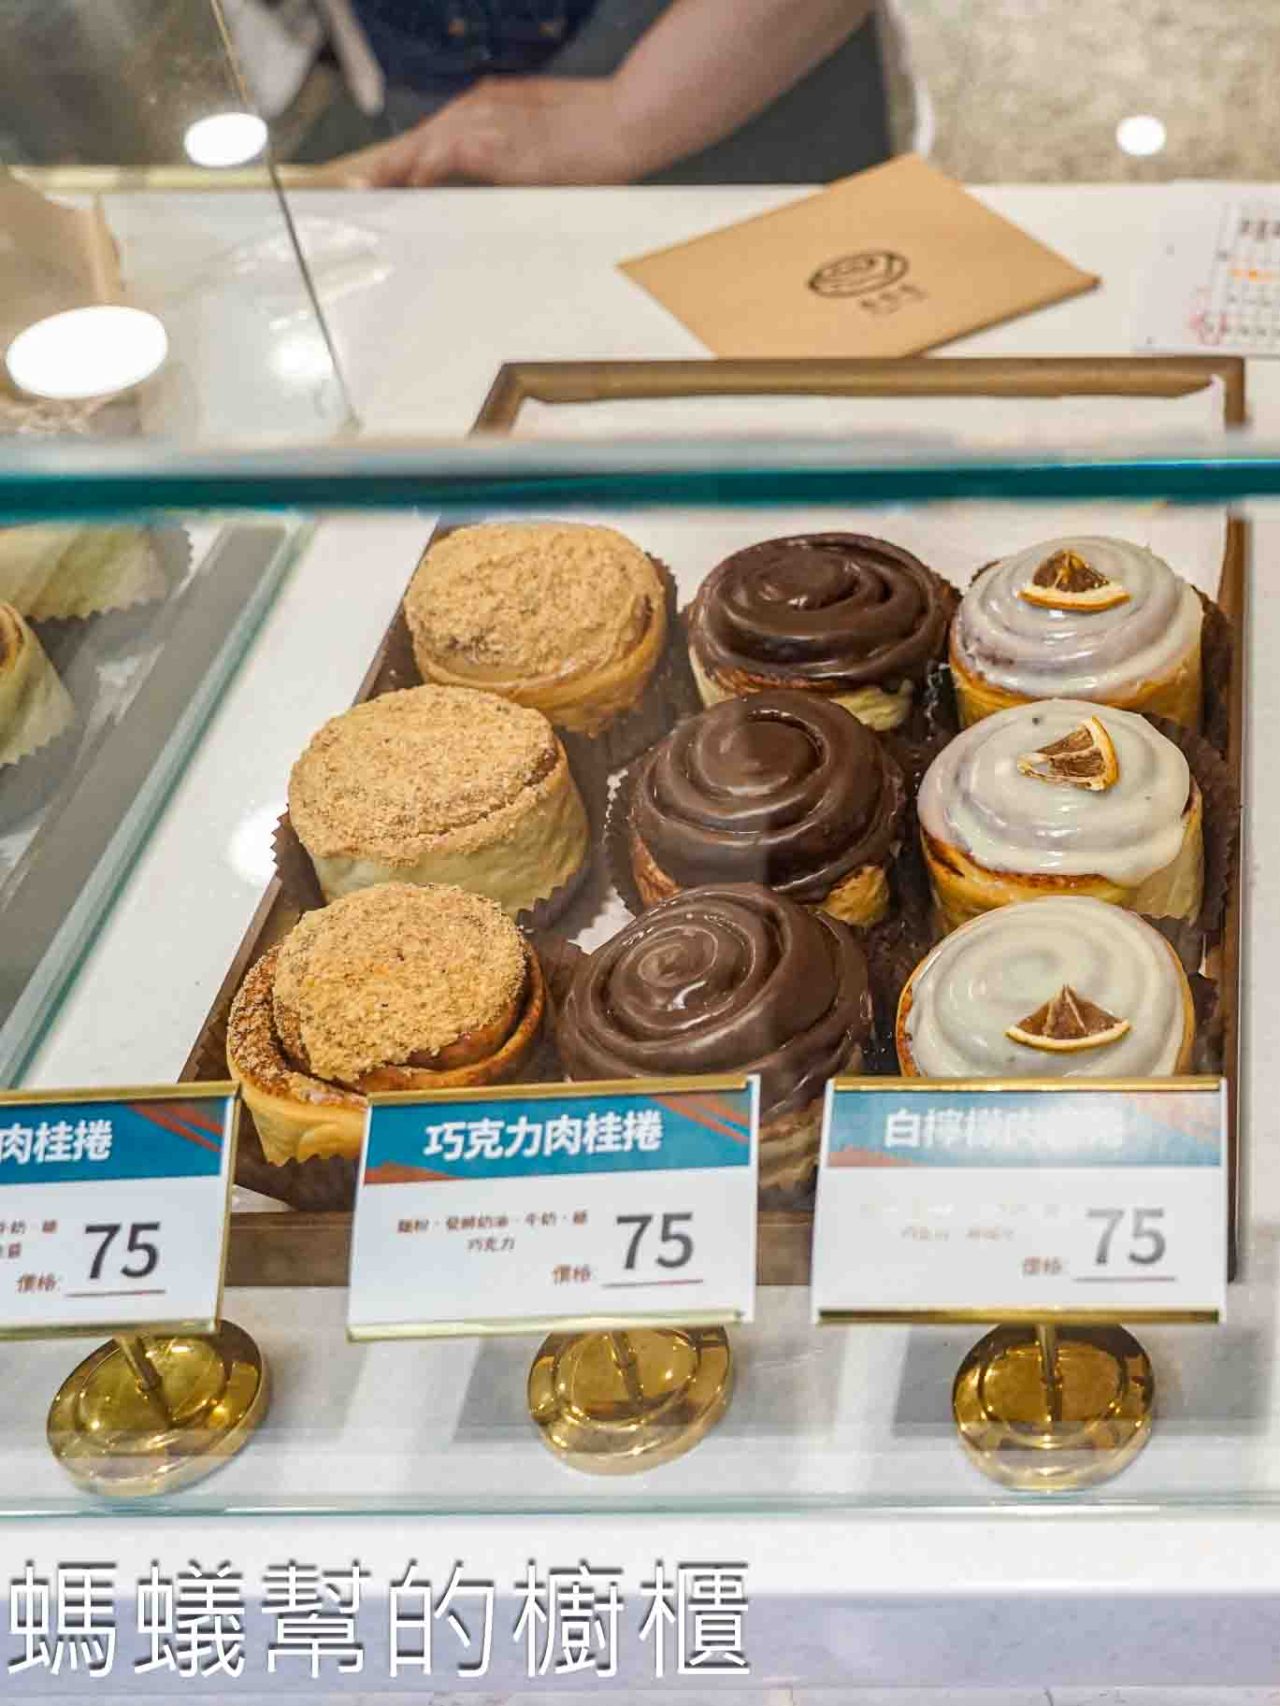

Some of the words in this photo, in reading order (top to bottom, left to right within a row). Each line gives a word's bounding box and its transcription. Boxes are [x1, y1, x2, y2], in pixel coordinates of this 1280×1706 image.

[423, 1109, 664, 1161] 巧克力肉桂捲
[884, 1106, 1124, 1149] 白檸檬肉
[85, 1221, 161, 1279] 75
[616, 1211, 694, 1271] 75
[1086, 1207, 1166, 1265] 75
